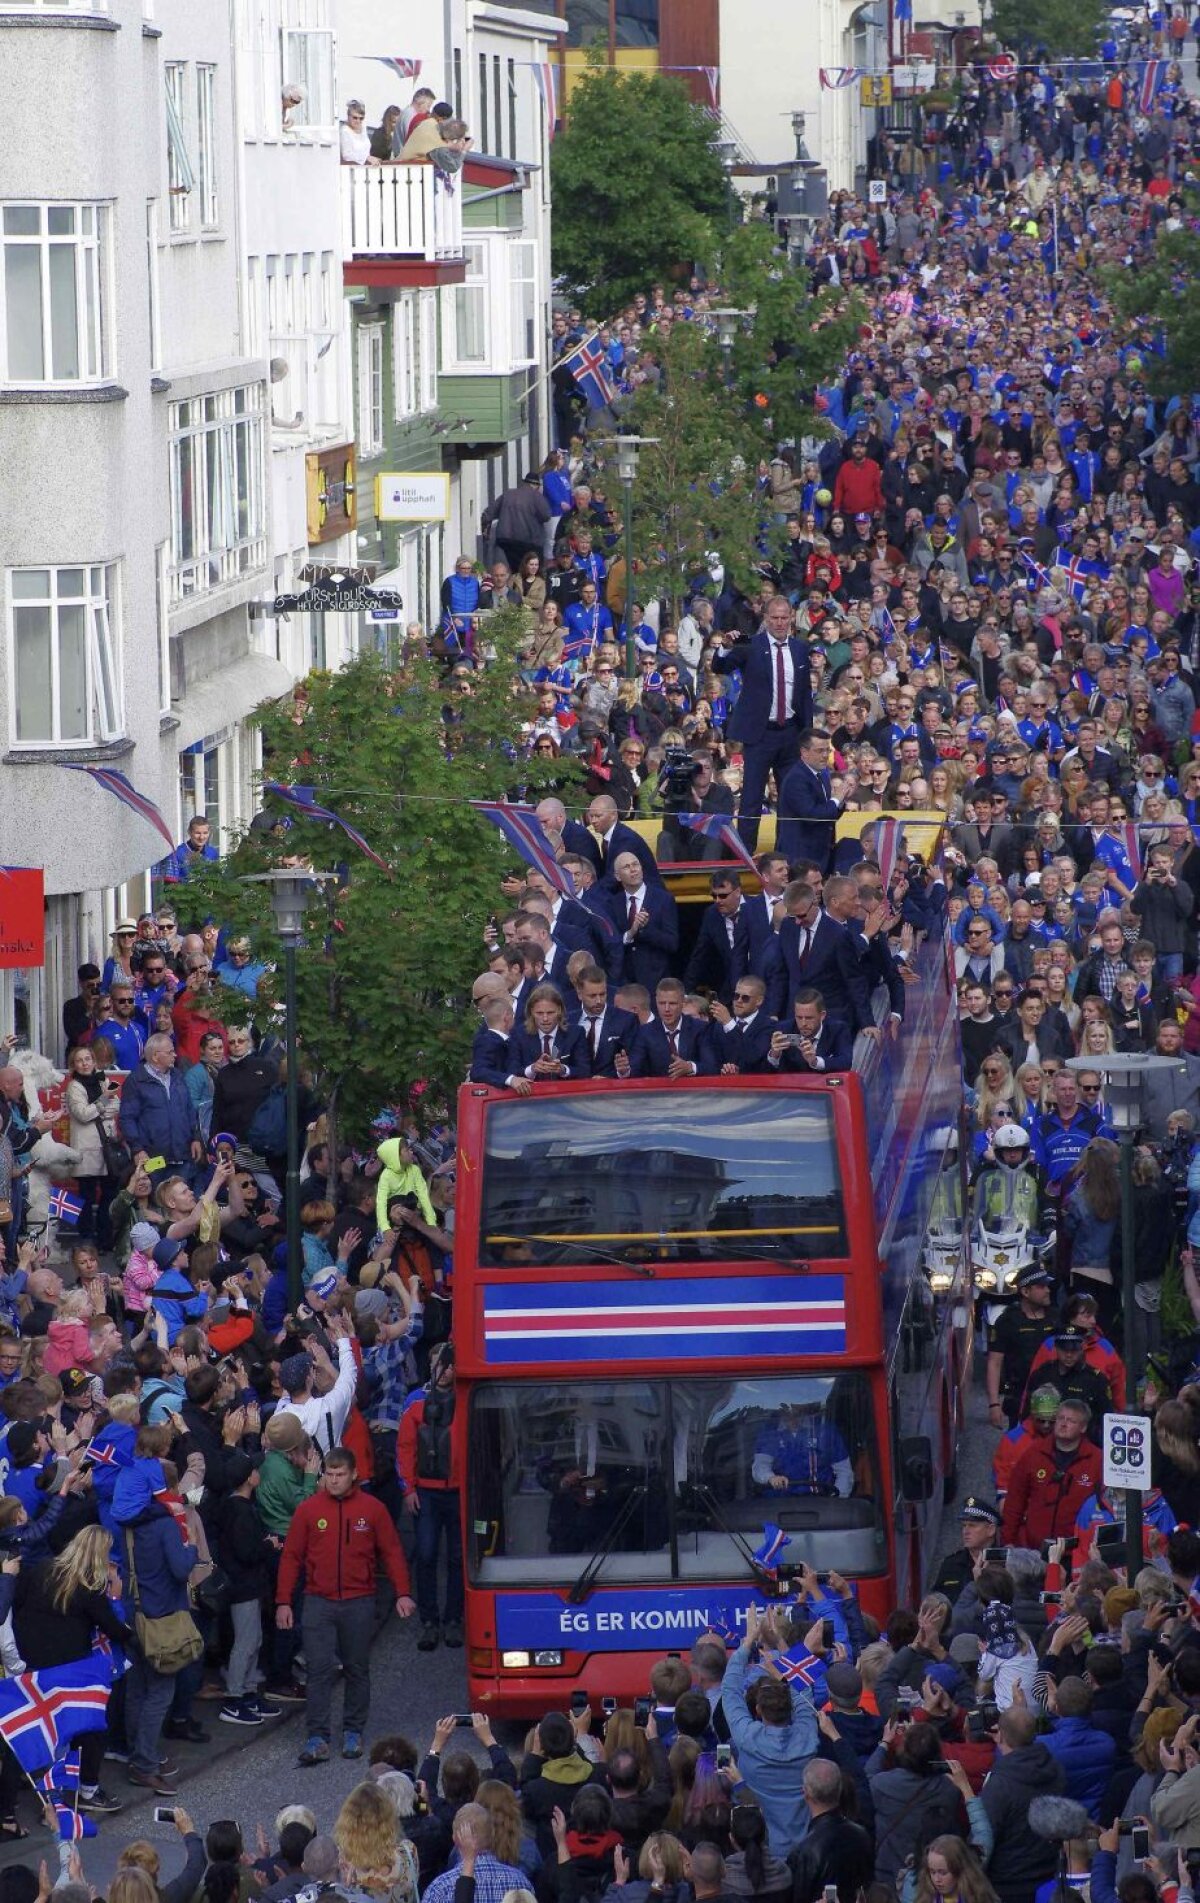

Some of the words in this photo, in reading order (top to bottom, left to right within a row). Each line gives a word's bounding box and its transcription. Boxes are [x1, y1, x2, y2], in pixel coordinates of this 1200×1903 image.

[560, 1609, 589, 1632] ÉG
[596, 1612, 624, 1631] ER
[631, 1608, 725, 1630] KOMIN
